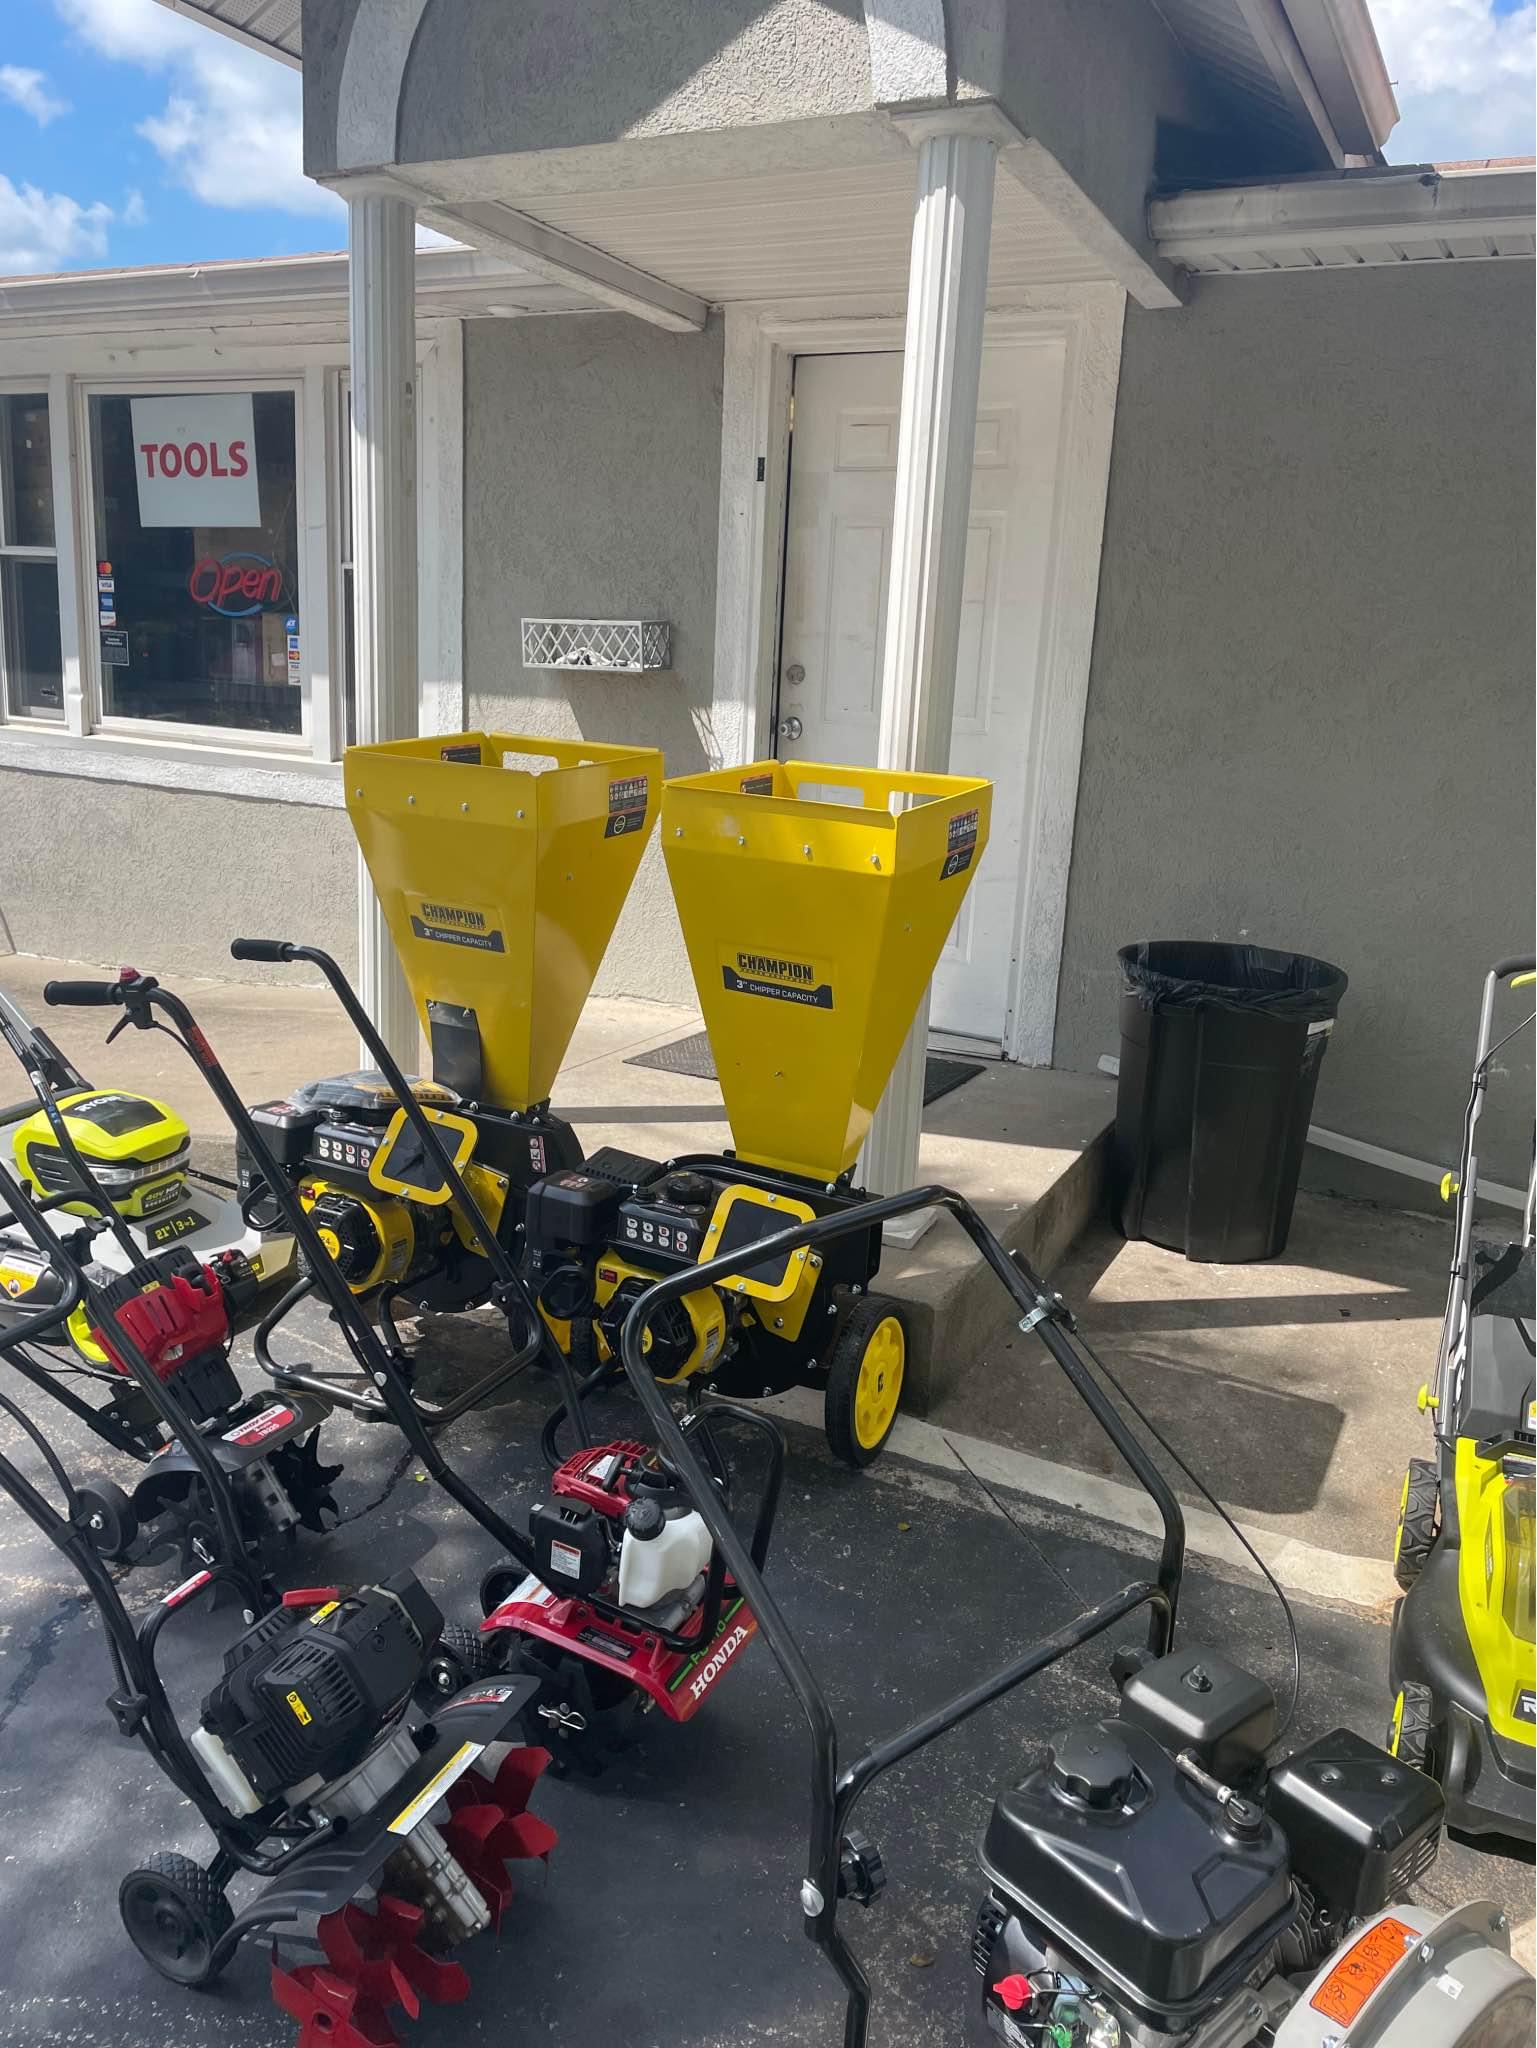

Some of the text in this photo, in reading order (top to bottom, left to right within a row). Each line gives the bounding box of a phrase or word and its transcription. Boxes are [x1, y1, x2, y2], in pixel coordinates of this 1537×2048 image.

[141, 441, 248, 478] TOOLS
[190, 559, 281, 608] Open
[422, 903, 485, 926] CHAMPION
[435, 931, 460, 942] CHIPPER
[461, 936, 492, 948] CAPACITY
[737, 953, 813, 981] CHAMPION
[750, 983, 780, 996] CHIPPER
[781, 990, 819, 1003] CAPACITY
[690, 1626, 748, 1700] HONDA
